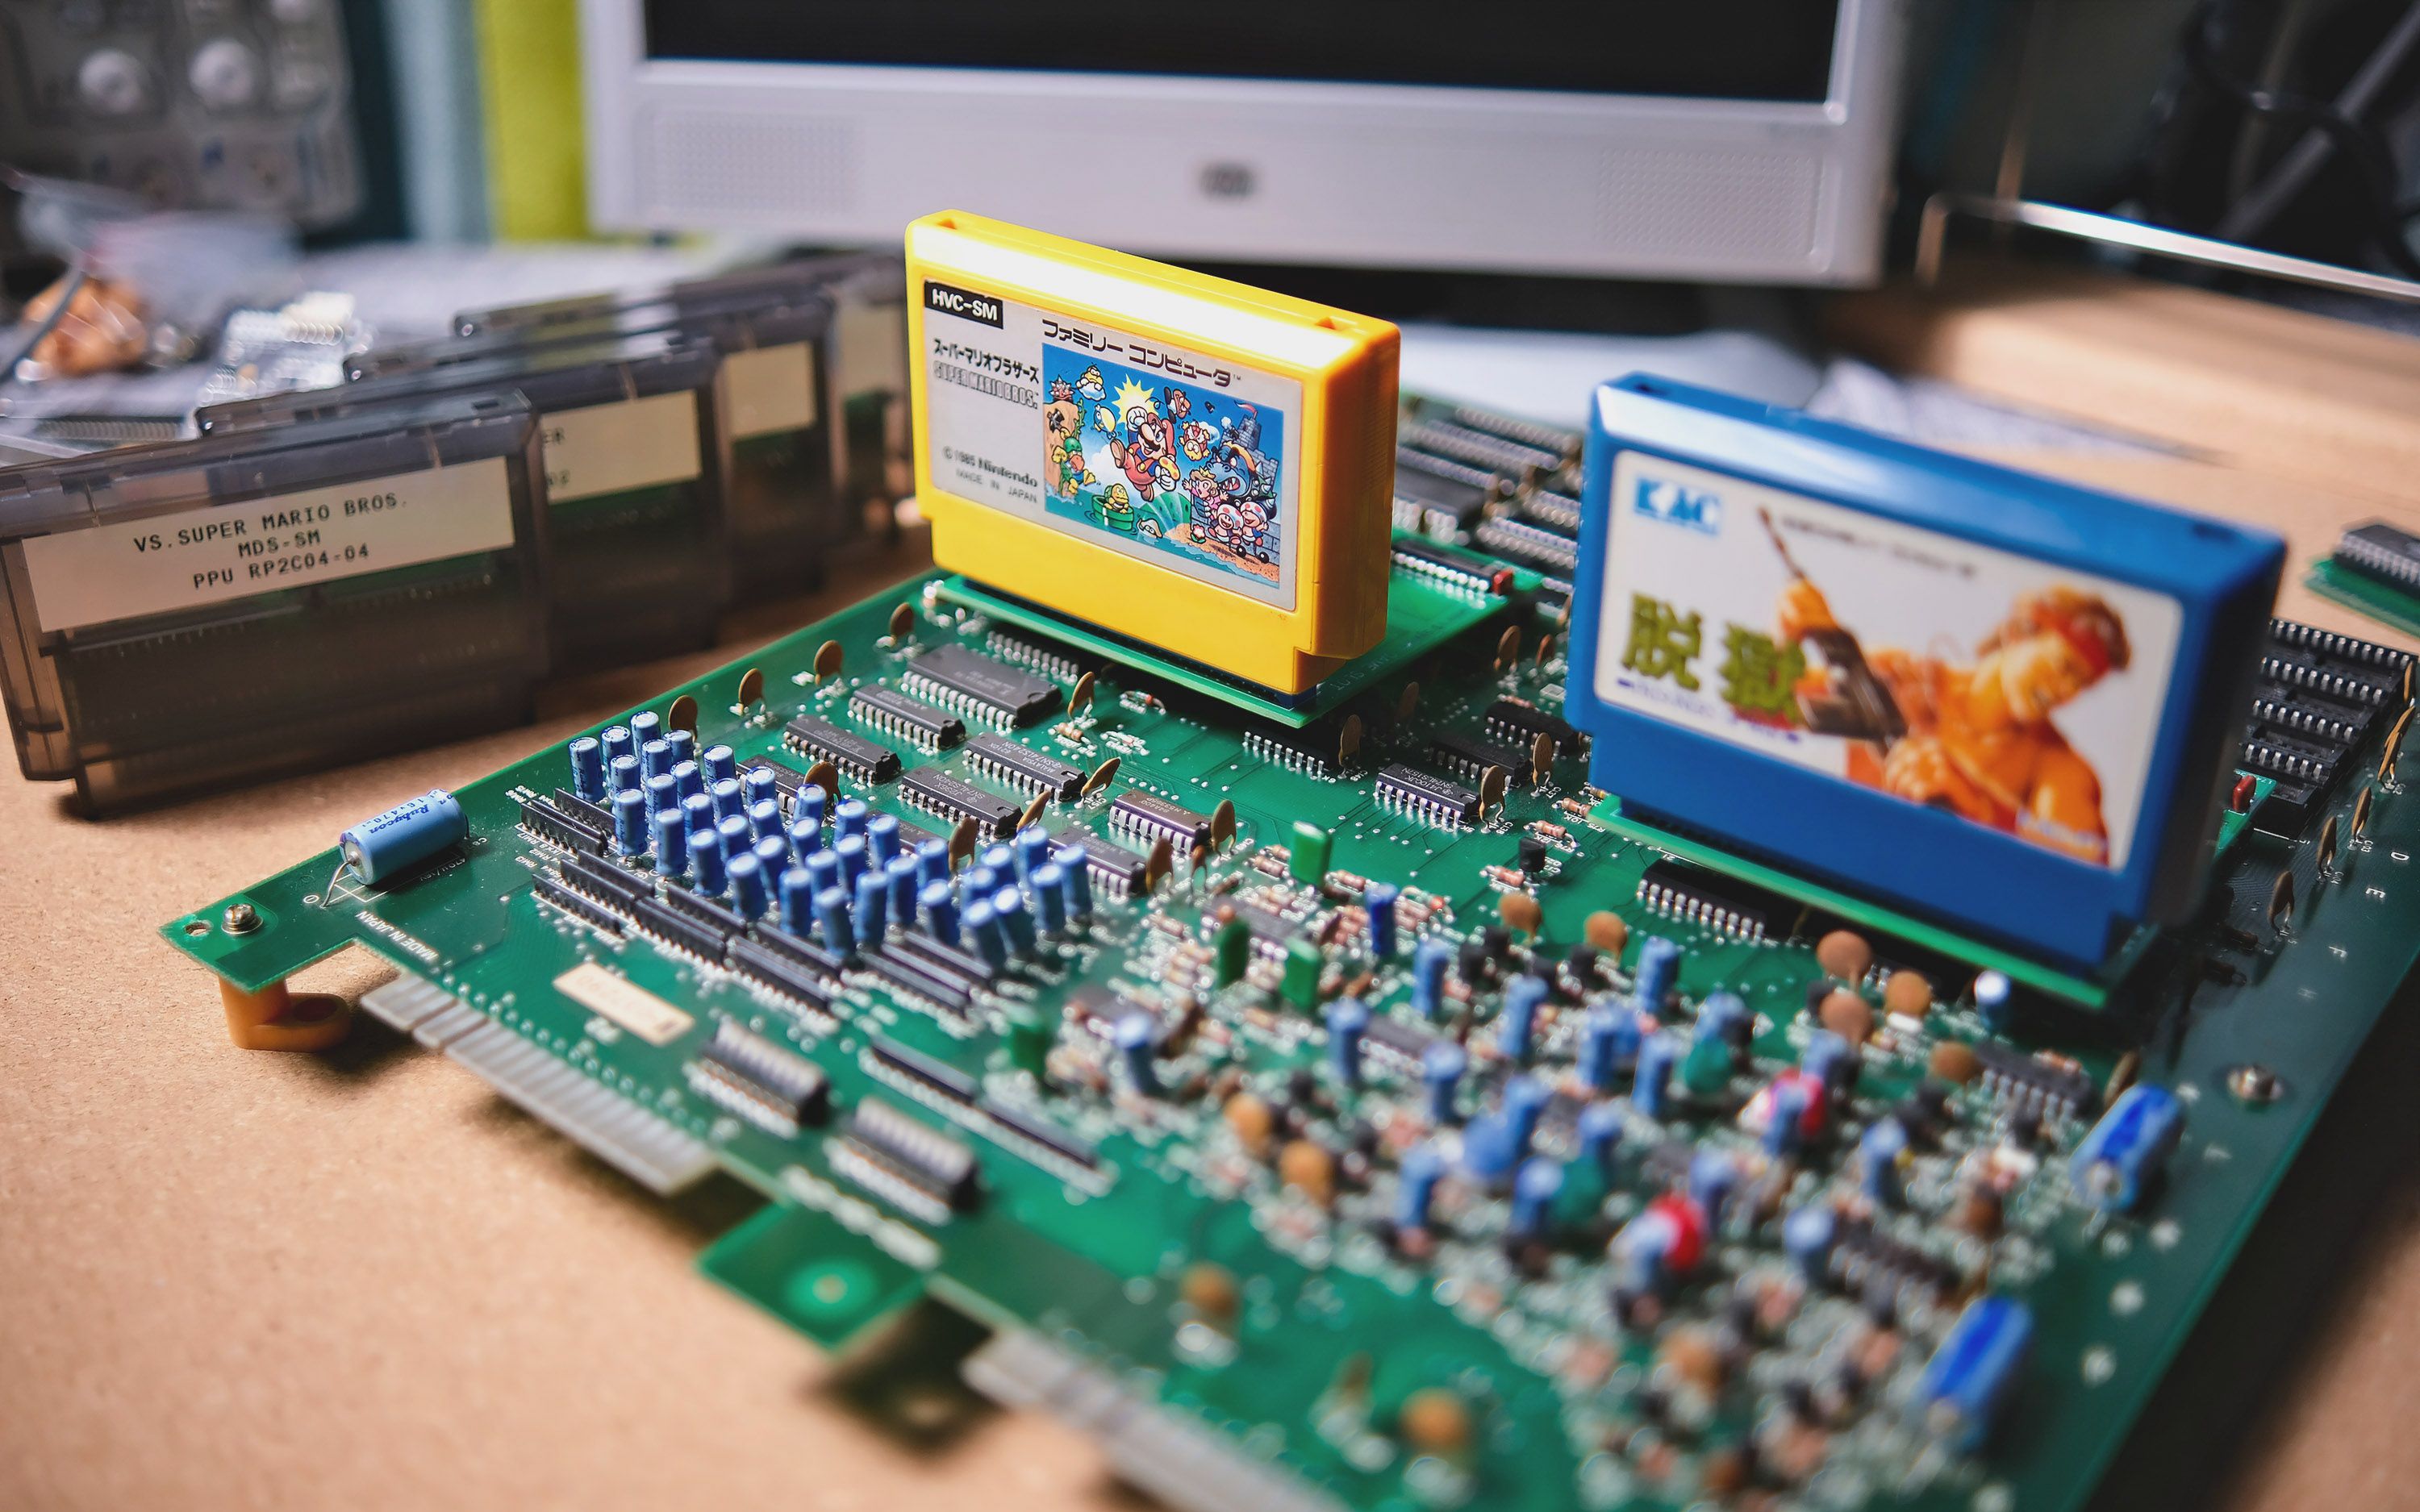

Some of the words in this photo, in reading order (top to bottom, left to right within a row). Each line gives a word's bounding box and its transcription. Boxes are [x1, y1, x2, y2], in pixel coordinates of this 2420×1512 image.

[932, 288, 998, 321] HVC-SM
[1042, 319, 1124, 352] ファミリー
[1129, 344, 1232, 387] コンピュータ
[968, 371, 1003, 398] MARIO
[956, 468, 983, 485] MADE
[991, 480, 1000, 490] IN
[1008, 485, 1038, 504] JAPAN
[978, 457, 1038, 488] Nintendo
[262, 503, 330, 531] MARIO
[238, 528, 321, 560] MDS-SM
[193, 568, 234, 589] PPU
[249, 543, 369, 581] RP2C04-04
[1022, 756, 1056, 773] MALAYSIA
[370, 804, 430, 834] Rubycon
[2390, 852, 2410, 861] D
[2365, 887, 2386, 898] E
[355, 910, 394, 932] JAPAN
[389, 930, 407, 942] IN
[400, 937, 439, 960] MADE
